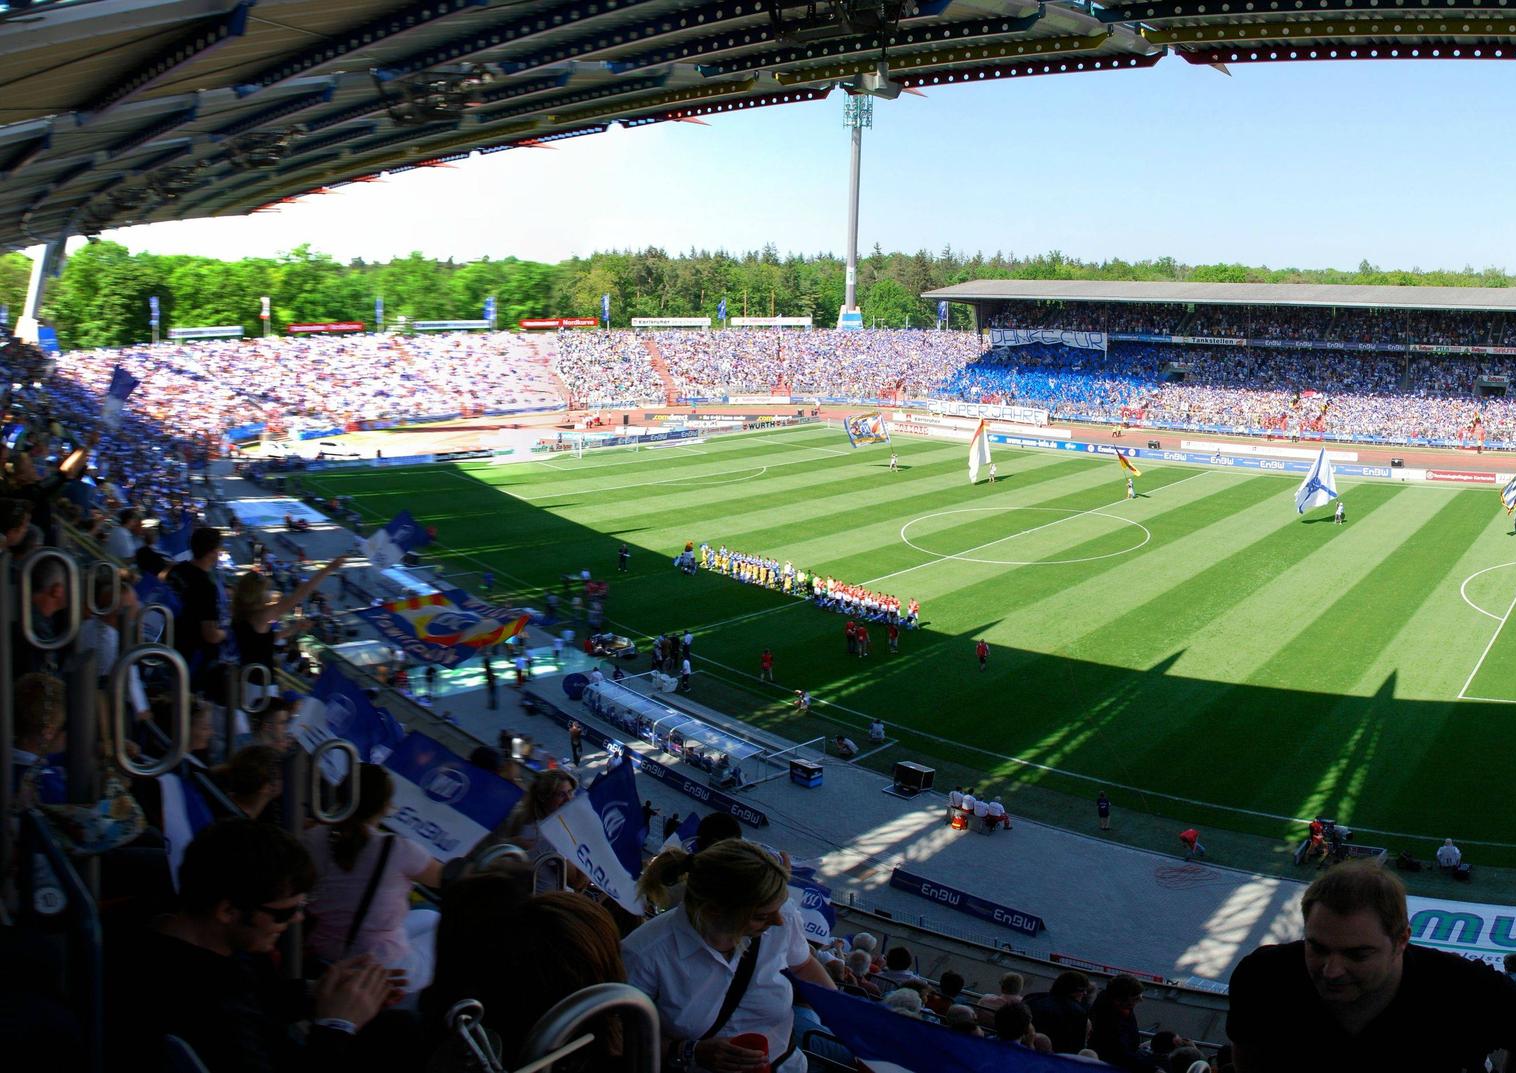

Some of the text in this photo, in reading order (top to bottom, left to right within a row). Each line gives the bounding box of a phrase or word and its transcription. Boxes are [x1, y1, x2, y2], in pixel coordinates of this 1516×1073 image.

[991, 329, 1058, 344] DANKE
[1192, 337, 1234, 345] Tankstellen
[1163, 452, 1187, 461] EnBW
[1210, 456, 1234, 465] EnBW
[1260, 459, 1285, 469] EnBW
[1362, 467, 1389, 477] EnBW
[640, 759, 666, 779] EnBW
[683, 781, 710, 801] EnBW
[730, 804, 761, 825] EnBW
[921, 882, 961, 906] EnBW
[993, 908, 1037, 932] EnBW
